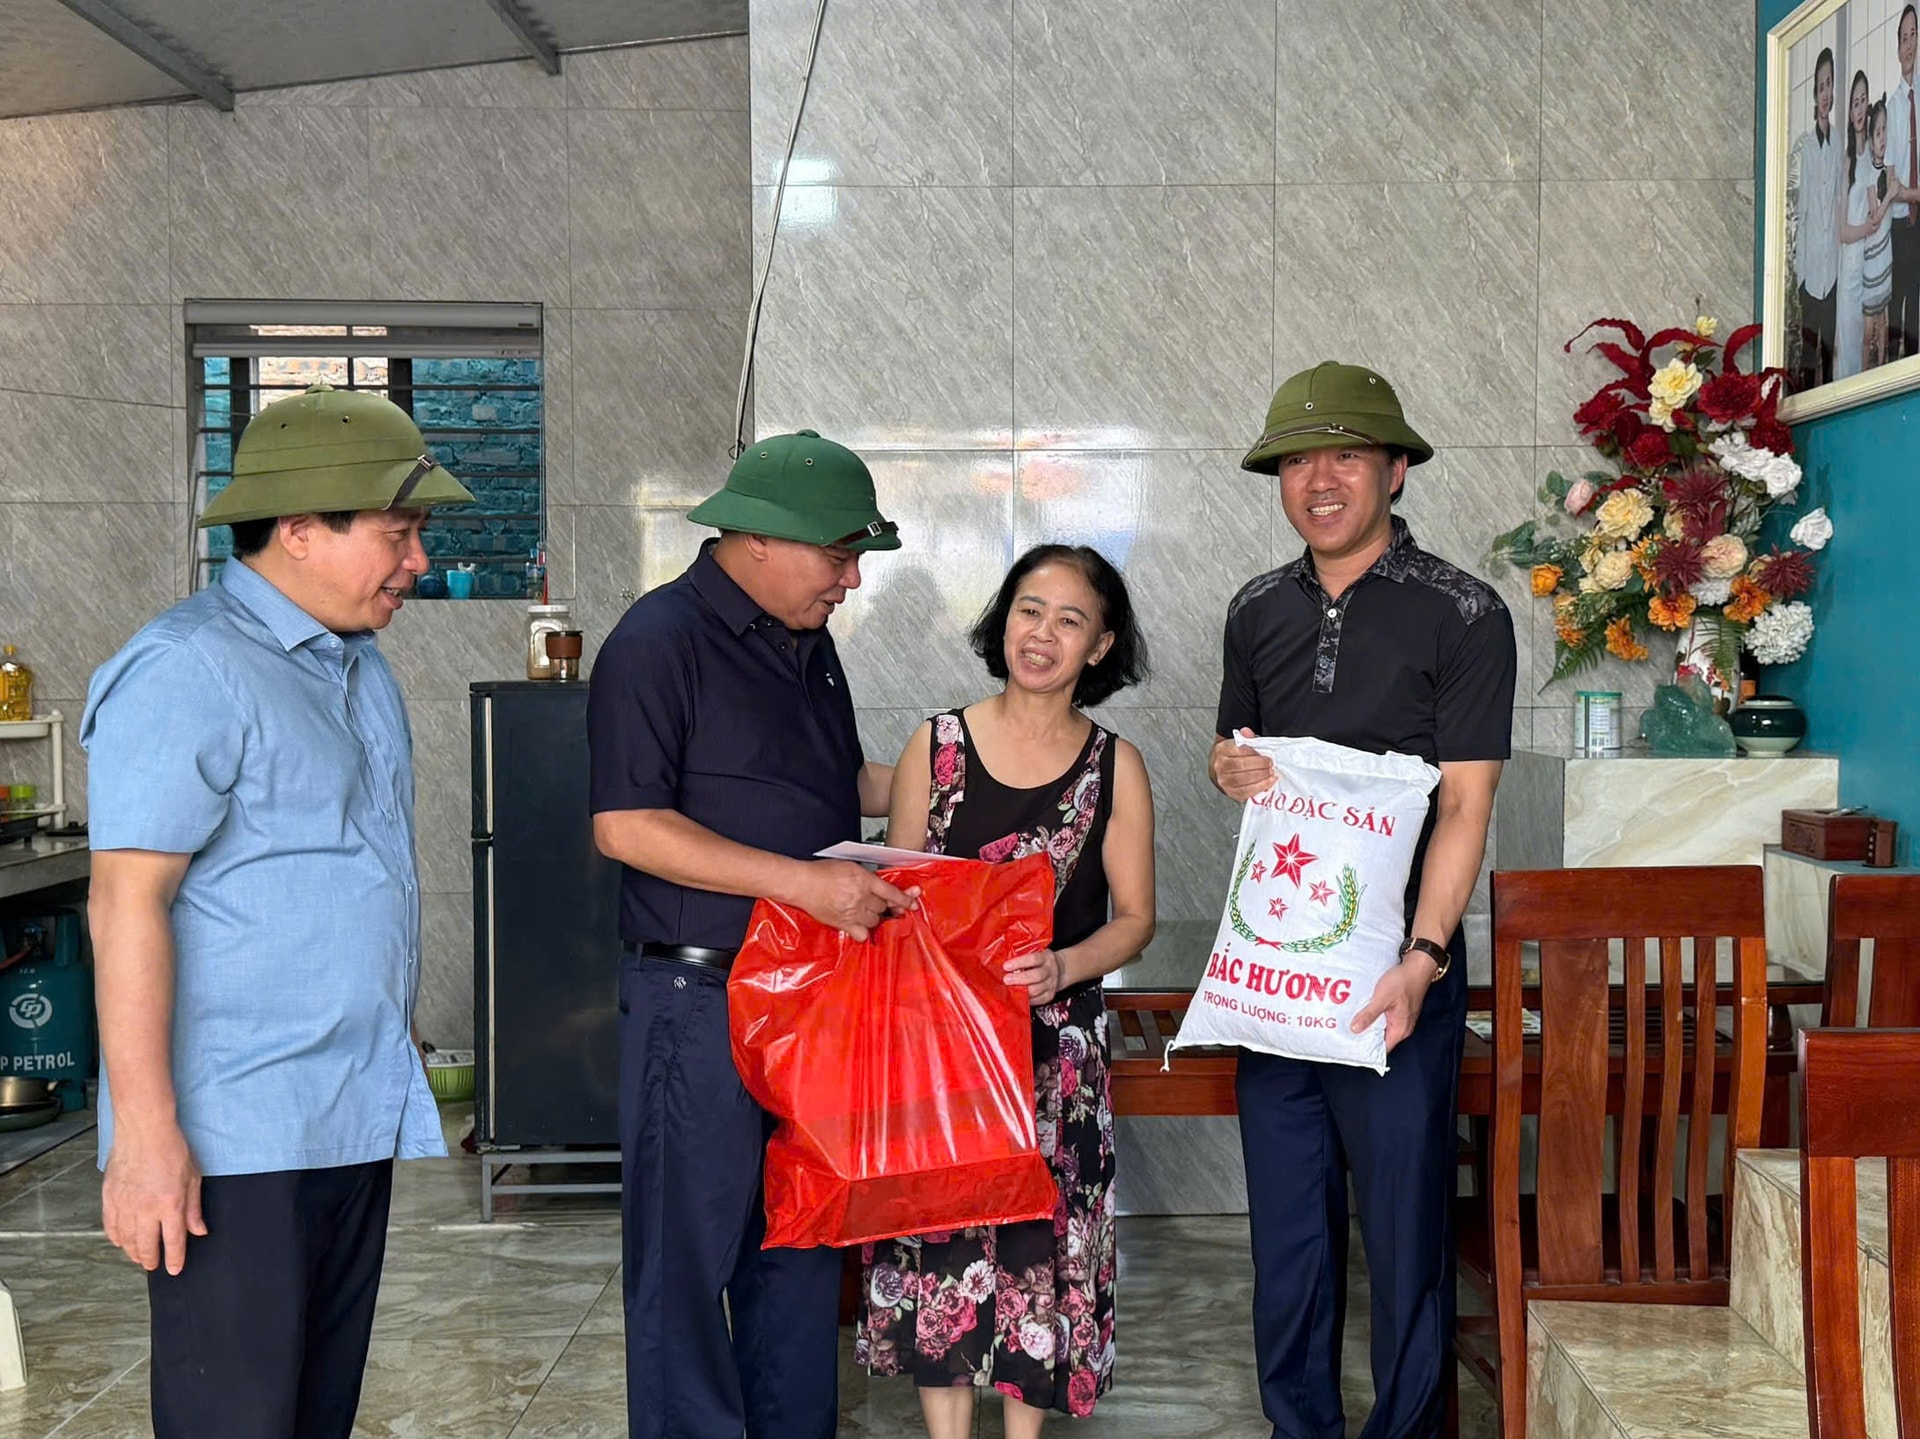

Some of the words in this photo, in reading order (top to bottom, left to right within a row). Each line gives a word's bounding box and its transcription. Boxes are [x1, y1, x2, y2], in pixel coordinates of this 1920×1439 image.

[1342, 806, 1396, 837] SẢN
[1206, 942, 1244, 985] BẮC
[1245, 963, 1352, 1005] HƯƠNG
[1203, 990, 1238, 1010] TRỌNG
[1241, 1002, 1292, 1025] LƯỢNG:
[1296, 1015, 1337, 1029] 10KG
[13, 1051, 76, 1072] PETROL
